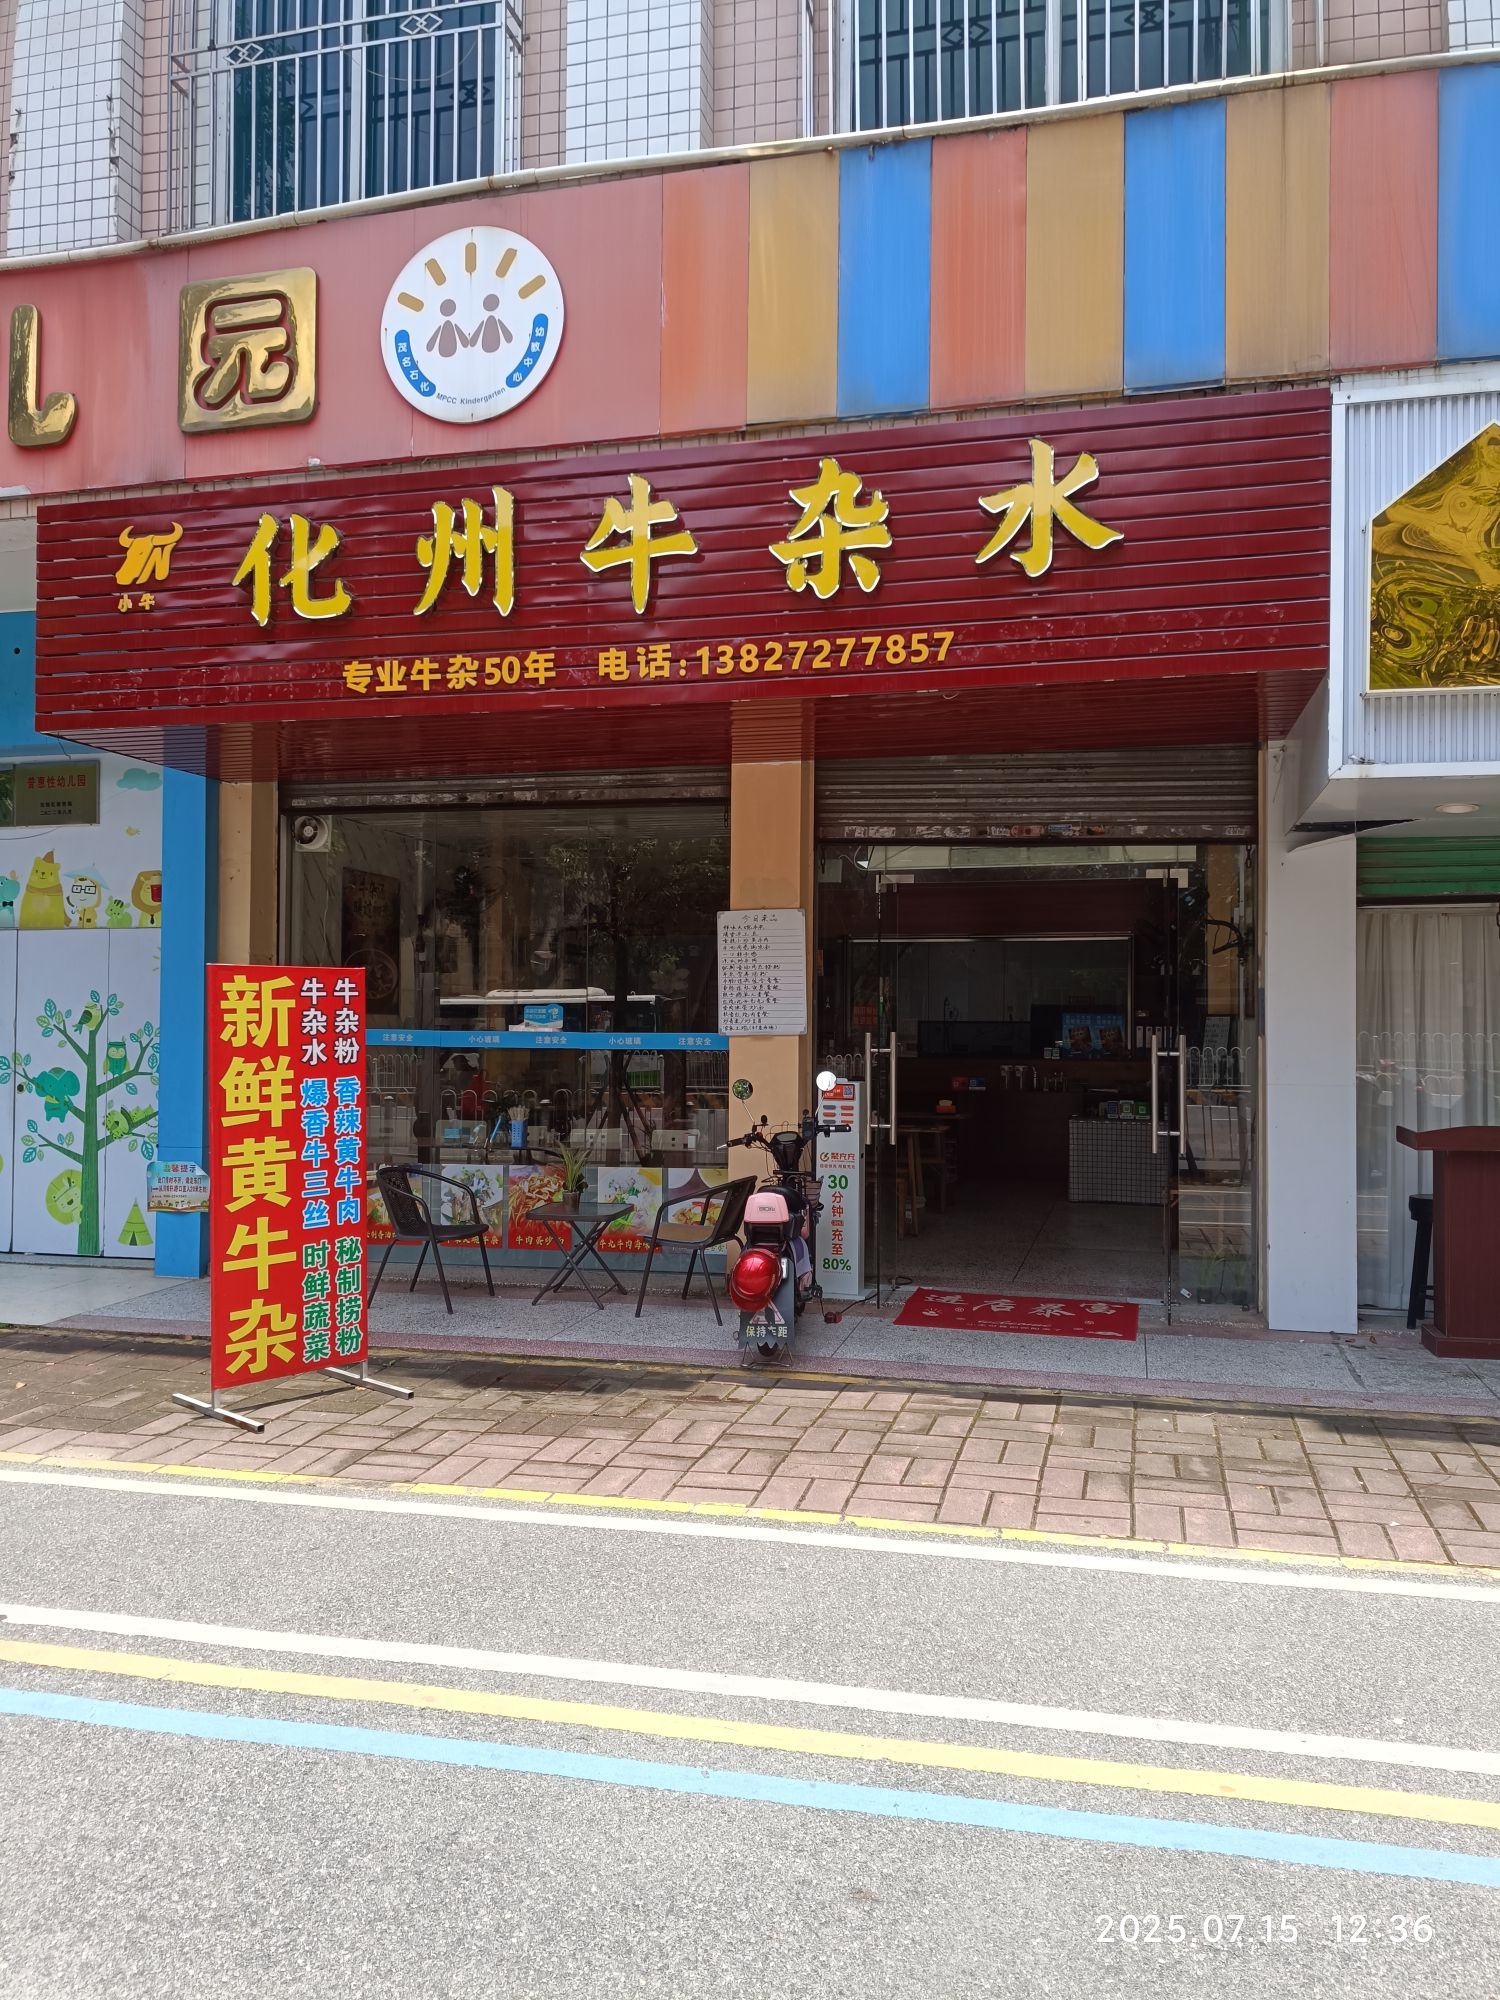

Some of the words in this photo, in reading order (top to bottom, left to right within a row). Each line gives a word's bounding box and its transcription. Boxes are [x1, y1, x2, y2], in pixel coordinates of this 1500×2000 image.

[512, 326, 545, 383] 幼教中心
[436, 392, 457, 405] MPCC
[460, 386, 506, 405] Kindergarten
[232, 438, 1125, 627] 化州牛杂水
[117, 592, 156, 613] 小牛
[341, 651, 556, 694] 专业牛杂50年
[26, 774, 87, 790] 普惠性幼儿园
[299, 977, 328, 1066] 牛杂水
[333, 977, 361, 1066] 牛杂粉
[382, 1033, 414, 1042] 注意安全
[468, 1035, 500, 1044] 小心玻璃
[535, 1036, 567, 1045] 注意安全
[608, 1036, 642, 1045] 小心玻璃
[678, 1037, 712, 1046] 注意安全
[218, 974, 297, 1375] 新鲜黄牛杂
[299, 1077, 330, 1231] 爆香牛三丝
[333, 1075, 362, 1225] 香辣黄牛肉
[828, 1175, 848, 1189] 30
[334, 1236, 363, 1356] 秘制捞粉
[822, 1258, 852, 1271] 80%
[302, 1243, 332, 1363] 时鲜蔬菜
